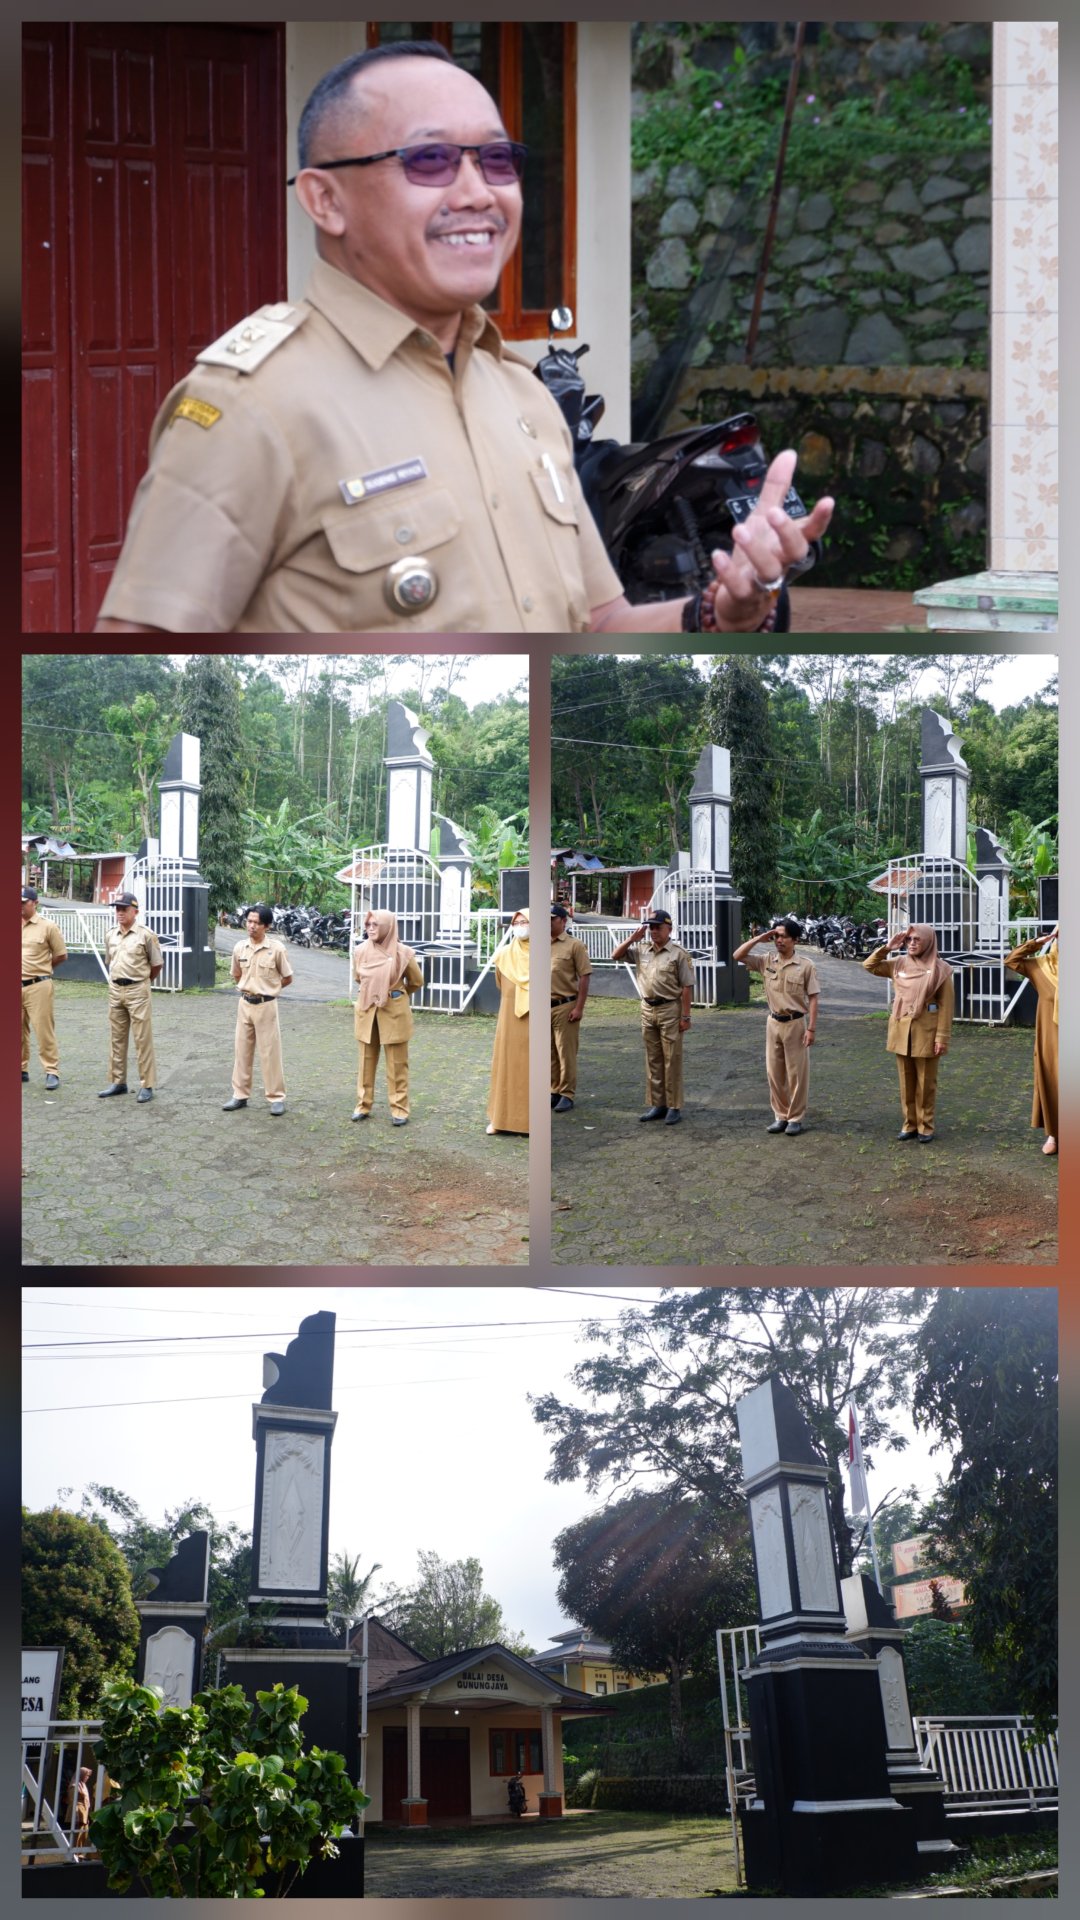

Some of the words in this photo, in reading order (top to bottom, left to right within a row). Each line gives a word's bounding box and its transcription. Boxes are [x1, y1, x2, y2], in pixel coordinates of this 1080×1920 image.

[462, 1672, 484, 1681] BALAI
[486, 1673, 505, 1682] DESA
[457, 1681, 509, 1690] GUNUNGJAYA
